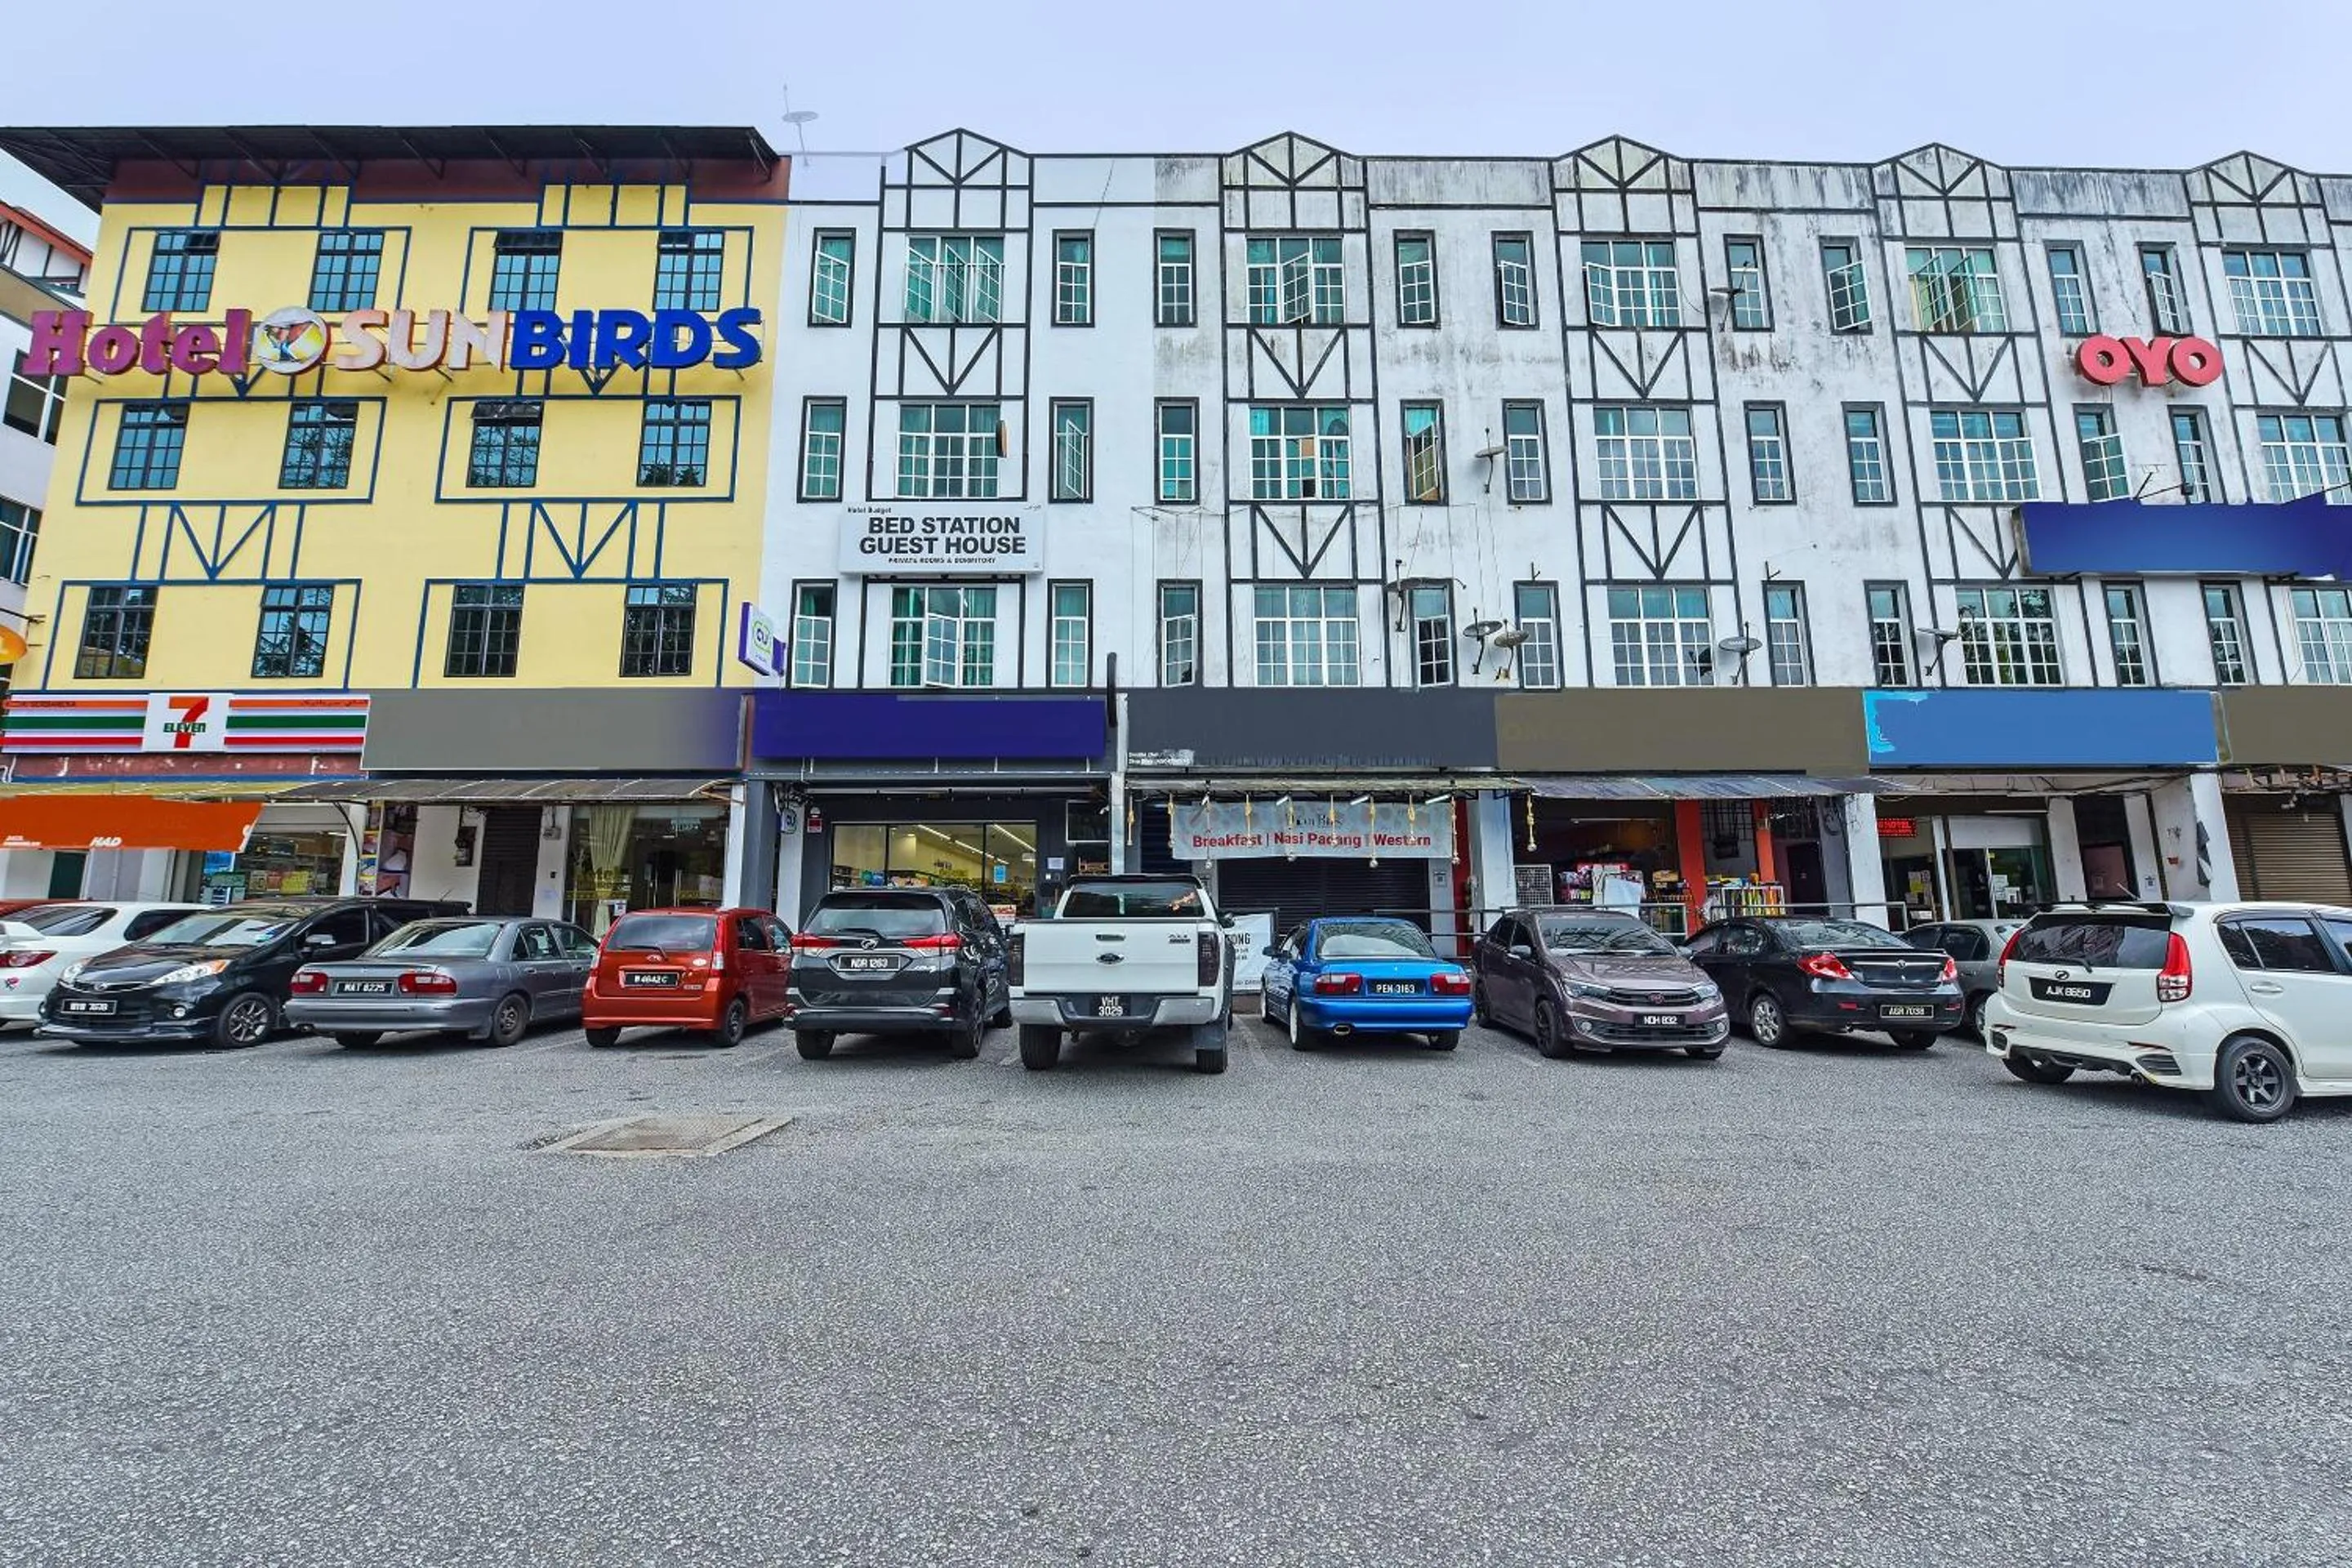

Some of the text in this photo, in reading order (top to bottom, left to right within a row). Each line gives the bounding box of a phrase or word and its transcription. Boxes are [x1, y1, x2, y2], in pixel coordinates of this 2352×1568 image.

[22, 306, 764, 376] Hotel SUN BIRDS
[2075, 335, 2224, 388] OYO
[869, 517, 1020, 534] BED STATION
[859, 537, 1026, 555] GUEST HOUSE
[163, 696, 209, 748] 7 ELEVEN
[1192, 833, 1263, 848] Breakfast
[1274, 832, 1304, 844] Nasi
[1375, 983, 1393, 994] PEN
[2046, 986, 2065, 996] AJK
[1098, 1005, 1124, 1017] 3029
